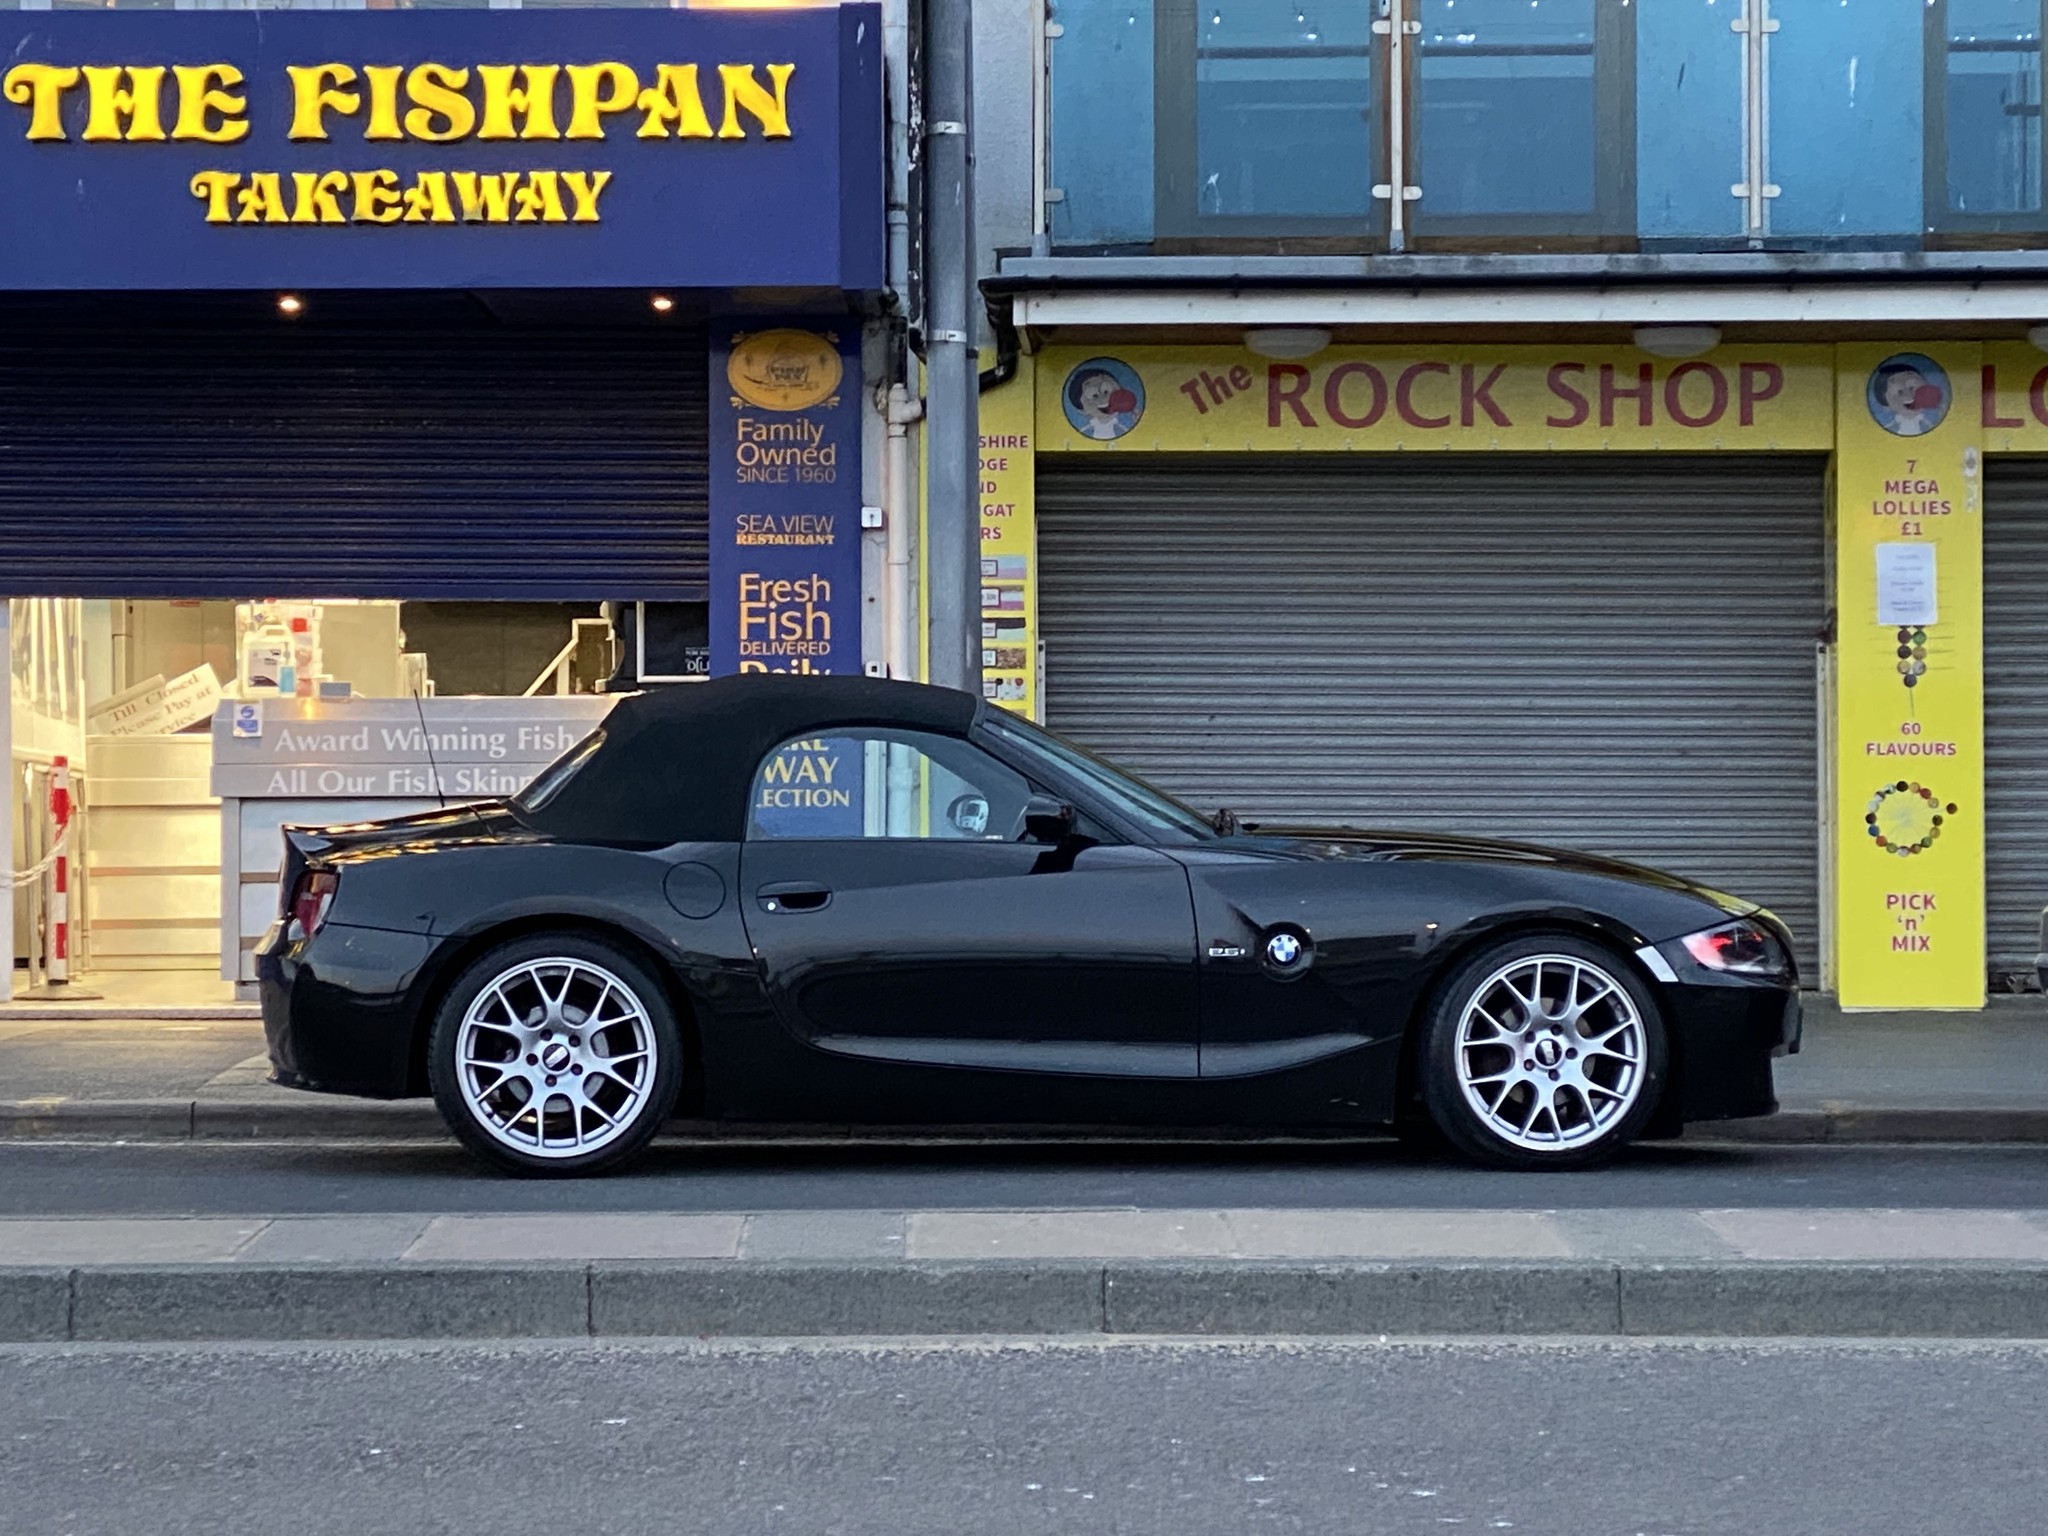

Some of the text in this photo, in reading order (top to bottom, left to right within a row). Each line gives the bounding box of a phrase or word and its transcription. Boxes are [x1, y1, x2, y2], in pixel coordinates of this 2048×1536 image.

[3, 62, 796, 143] THE FISHPAN
[191, 169, 612, 224] TAKEAWAY
[1180, 362, 1783, 429] The ROCK SHOP
[737, 418, 825, 447] Family
[736, 442, 837, 467] Owned
[736, 466, 837, 484] SINCE 1960
[1906, 459, 1919, 474] 7
[1884, 480, 1940, 495] MEGA
[983, 504, 1016, 517] GAT
[1872, 500, 1952, 516] LOLLIES
[736, 514, 835, 534] SEA VIEW
[1900, 521, 1923, 536] £1
[735, 533, 836, 546] RESTAURANT
[739, 573, 832, 603] Fresh
[739, 601, 832, 641] Fish
[739, 641, 832, 656] DELIVERED
[740, 658, 831, 675] Dil
[108, 673, 200, 722] Till Closed
[164, 694, 192, 715] Pay
[154, 711, 197, 735] rvice
[1900, 722, 1922, 736] 60
[274, 726, 369, 751] Award
[381, 726, 507, 759] Winning
[518, 725, 575, 750] Fish
[1866, 742, 1957, 757] FLAVOURS
[764, 755, 839, 784] WAY
[267, 769, 307, 793] All
[318, 769, 376, 793] Our
[388, 768, 445, 793] Fish
[756, 788, 850, 808] ECTION
[1886, 894, 1937, 911] PICK
[1892, 935, 1932, 952] MIX
